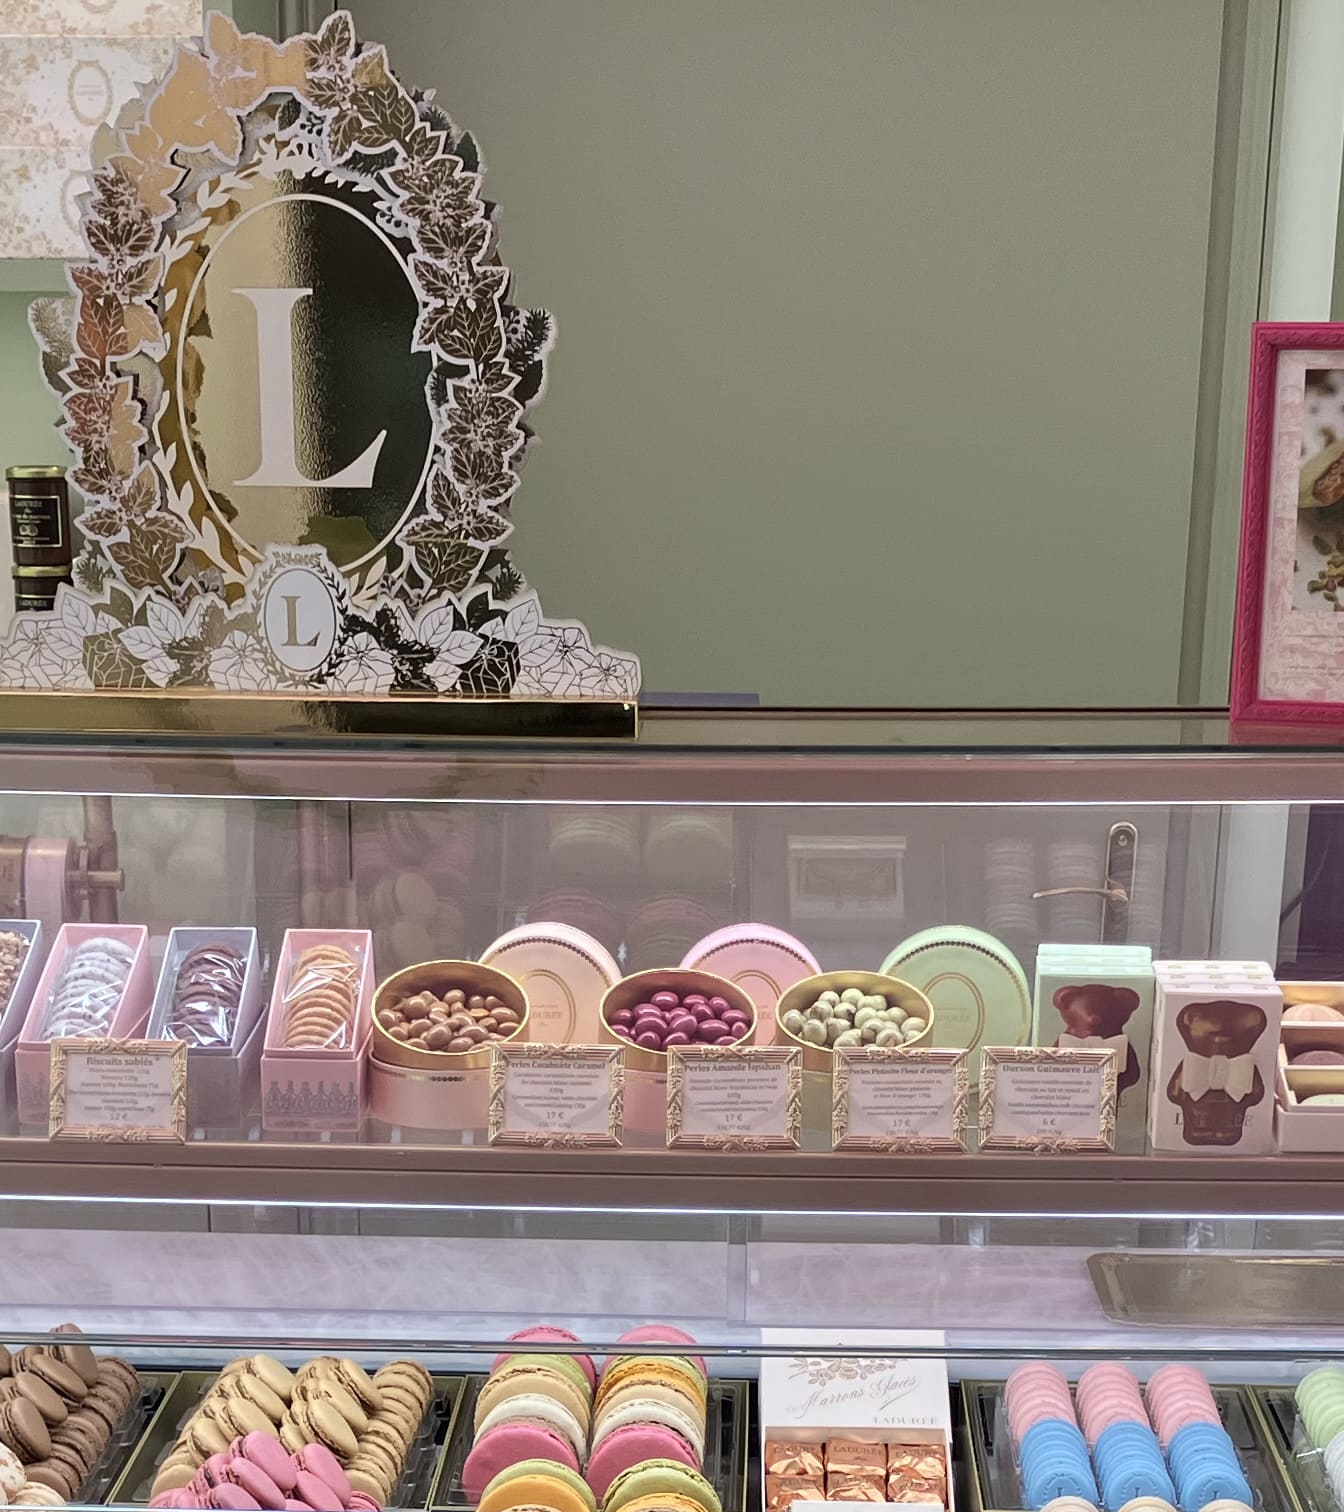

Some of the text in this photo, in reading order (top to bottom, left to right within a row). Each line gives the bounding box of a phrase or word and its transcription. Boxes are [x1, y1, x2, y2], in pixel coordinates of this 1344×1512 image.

[231, 287, 387, 488] L
[280, 595, 320, 647] L
[86, 1056, 153, 1066] Biscuits sablés
[684, 1064, 710, 1072] Perles
[711, 1064, 746, 1072] Amande
[1002, 1064, 1035, 1072] Ourson
[1037, 1064, 1081, 1073] Guimauve
[122, 1112, 128, 1120] €
[547, 1111, 565, 1119] 17 €
[893, 1119, 903, 1127] 17
[1050, 1118, 1056, 1126] €
